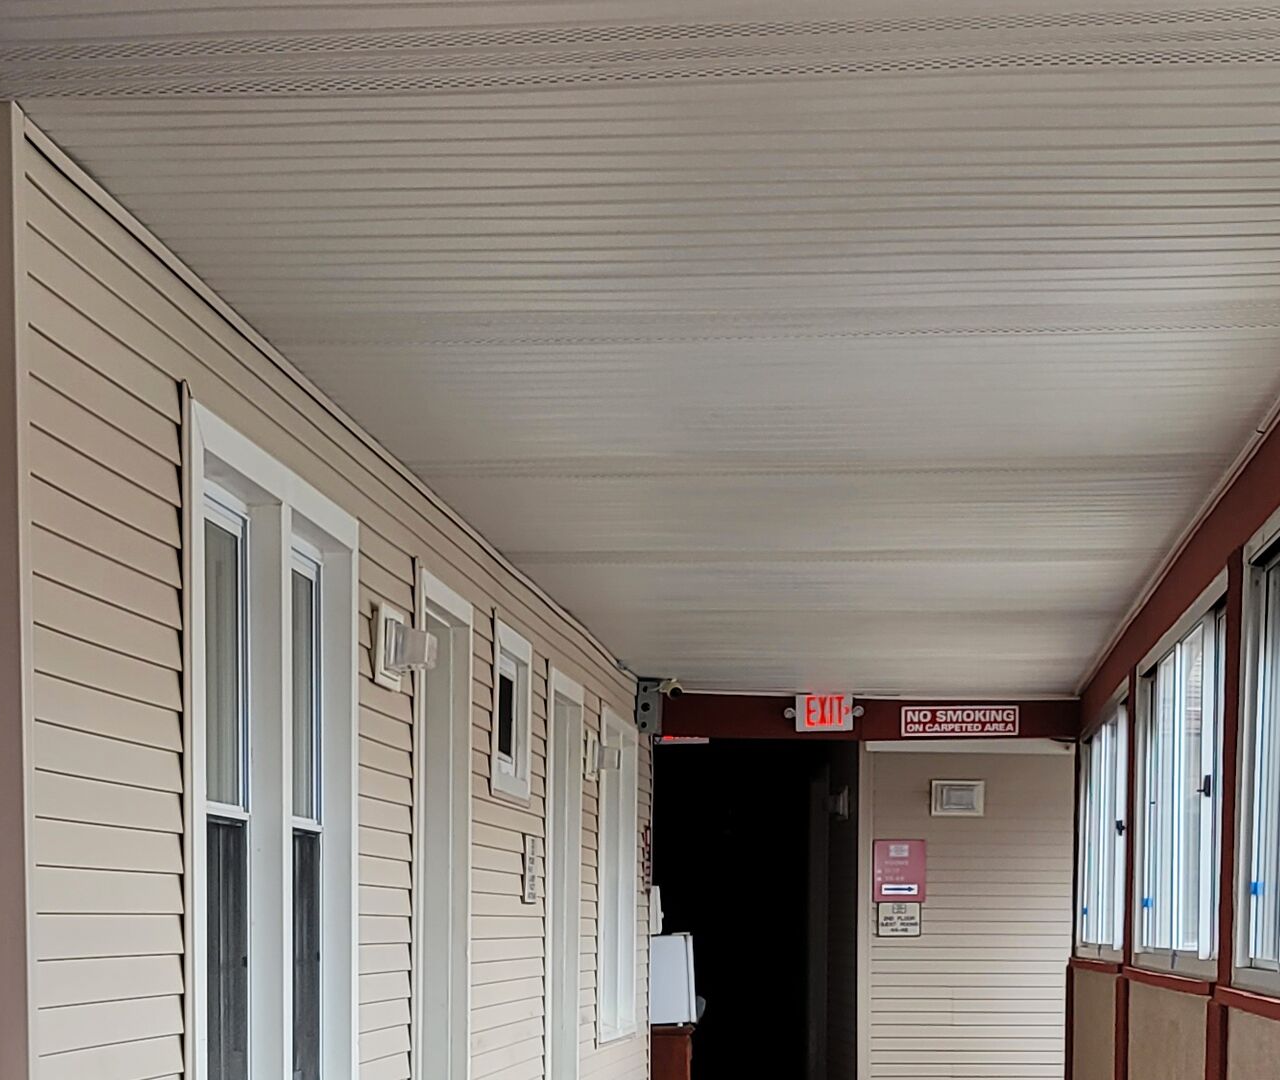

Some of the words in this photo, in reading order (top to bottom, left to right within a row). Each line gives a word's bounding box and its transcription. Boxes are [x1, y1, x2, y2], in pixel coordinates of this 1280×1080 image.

[805, 695, 845, 728] EXIT
[906, 710, 932, 723] NO
[935, 710, 1015, 723] SMOKING
[906, 723, 922, 732] ON
[925, 722, 982, 732] CARPETED
[984, 722, 1014, 732] AREA
